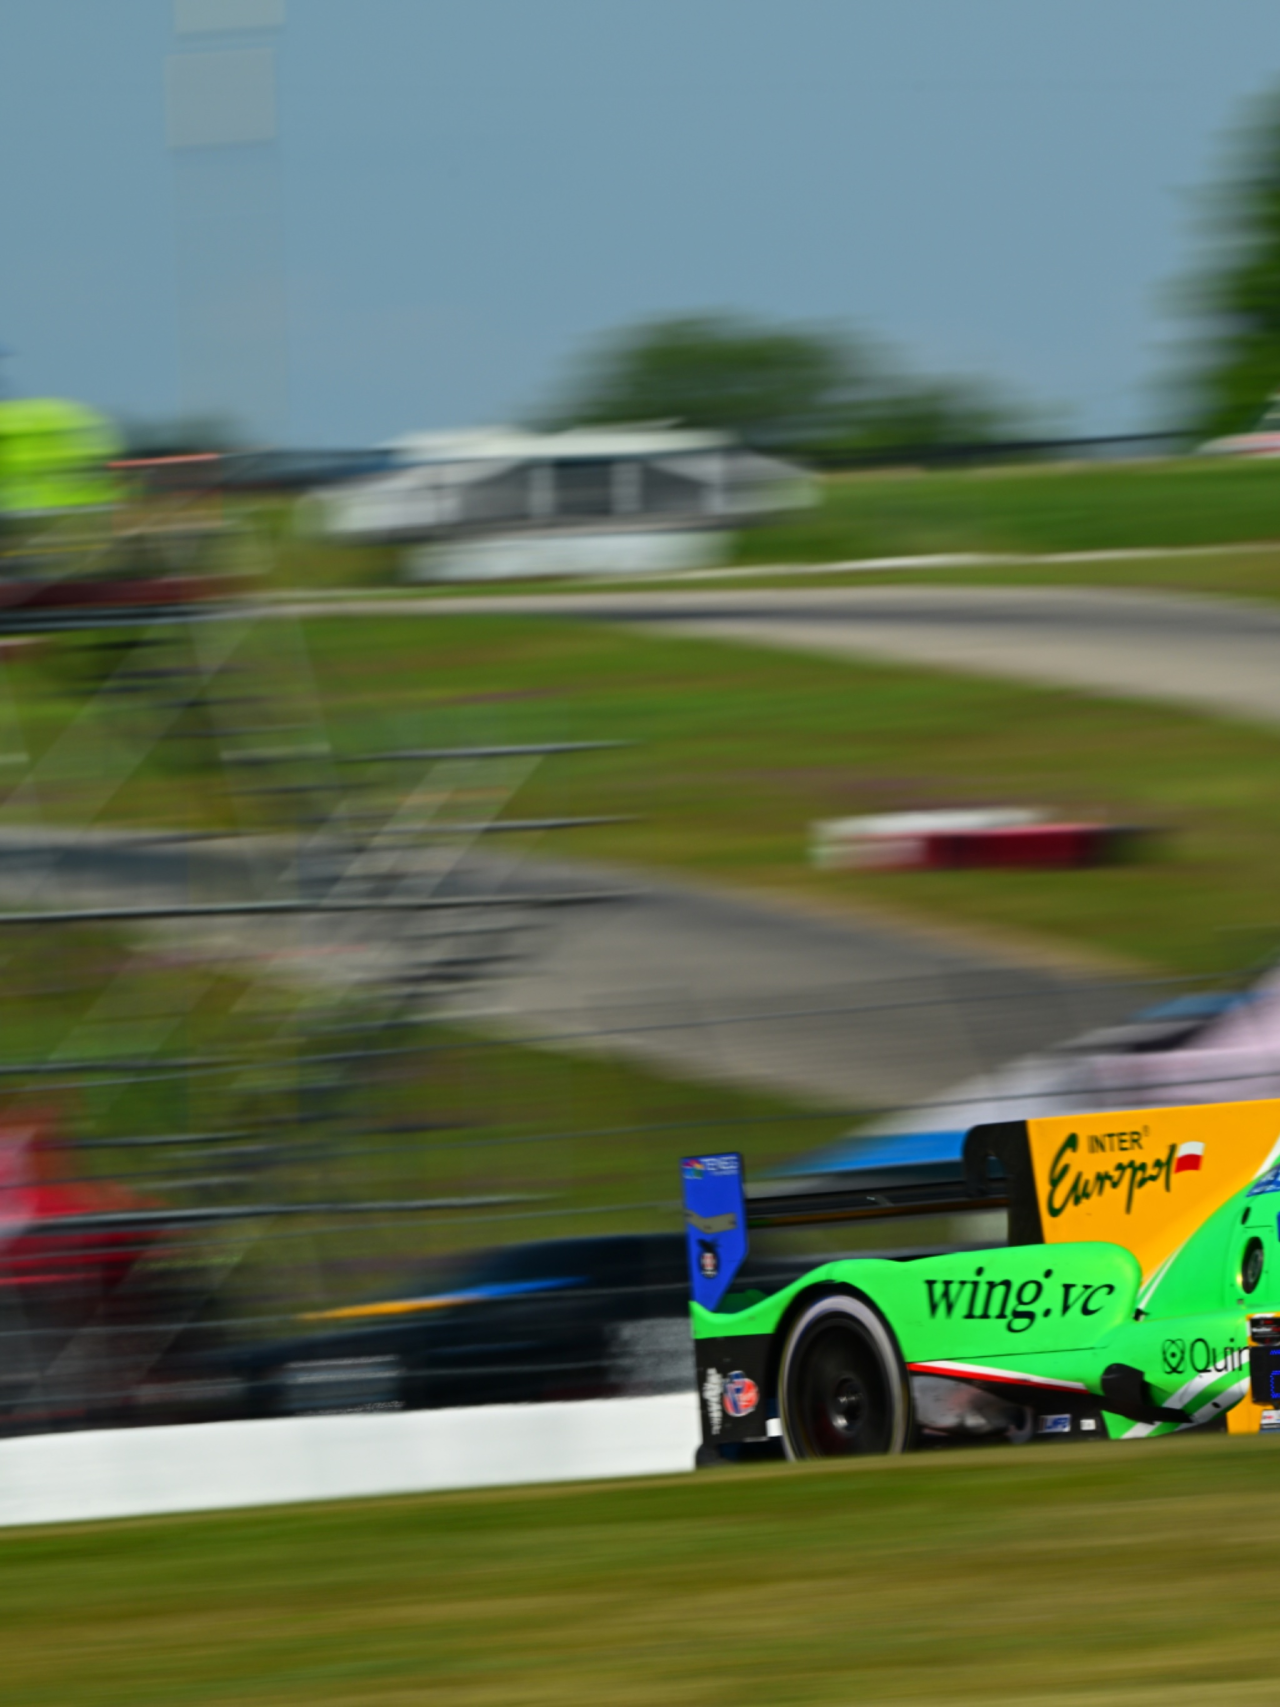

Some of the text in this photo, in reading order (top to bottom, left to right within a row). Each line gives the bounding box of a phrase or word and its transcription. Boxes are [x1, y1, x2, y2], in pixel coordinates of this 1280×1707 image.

[1047, 1132, 1178, 1218] Europol
[1087, 1131, 1143, 1154] INTER
[924, 1266, 1115, 1333] wing.vc
